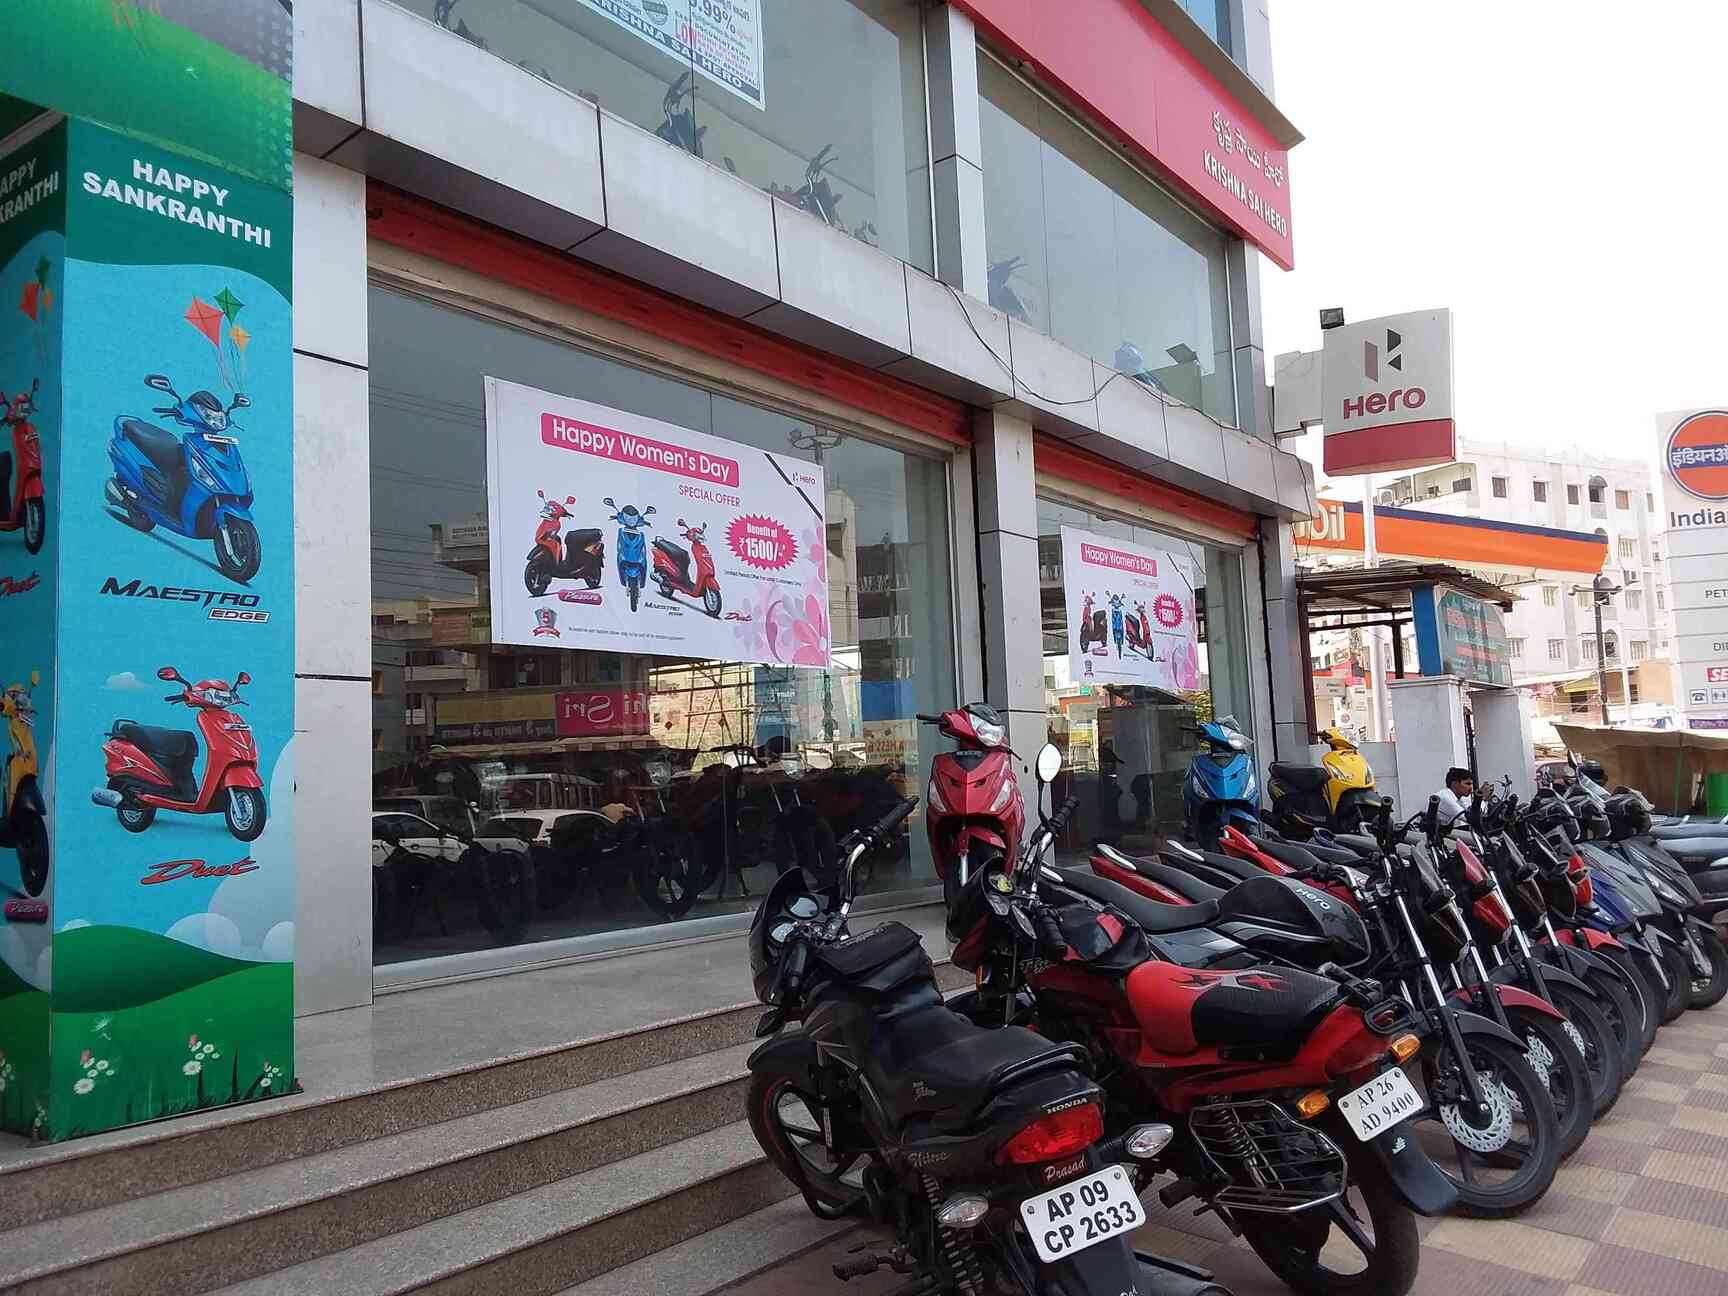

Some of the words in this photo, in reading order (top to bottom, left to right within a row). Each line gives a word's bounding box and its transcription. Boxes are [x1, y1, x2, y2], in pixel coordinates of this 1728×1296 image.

[671, 38, 697, 63] SAI
[701, 58, 743, 88] HERO
[133, 159, 229, 207] HAPPY
[1204, 150, 1247, 202] KRISHNA
[1247, 189, 1263, 219] SAI
[1264, 201, 1287, 238] HERO
[83, 171, 271, 248] SANKRANTHI
[1344, 387, 1426, 420] Hero
[553, 419, 616, 455] Happy
[619, 434, 697, 471] Women's
[699, 455, 730, 482] Day
[678, 484, 715, 503] SPECIAL
[715, 492, 741, 507] OFFER
[1085, 545, 1109, 565] Happy
[1109, 552, 1141, 571] Women's
[1140, 559, 1154, 576] Day
[100, 577, 260, 608] MAESTRO
[211, 610, 268, 621] EDGE
[140, 856, 259, 885] Duet
[1296, 888, 1330, 910] Hero
[1047, 1098, 1088, 1115] HONDA
[1357, 1087, 1375, 1110] AP
[1377, 1079, 1394, 1096] 26
[1360, 1113, 1381, 1135] AD
[1382, 1092, 1414, 1120] 9400
[1044, 1153, 1086, 1181] Prasad
[1047, 1192, 1075, 1223] AP
[1080, 1180, 1109, 1207] 09
[1044, 1223, 1075, 1254] CP
[1080, 1201, 1137, 1241] 2633
